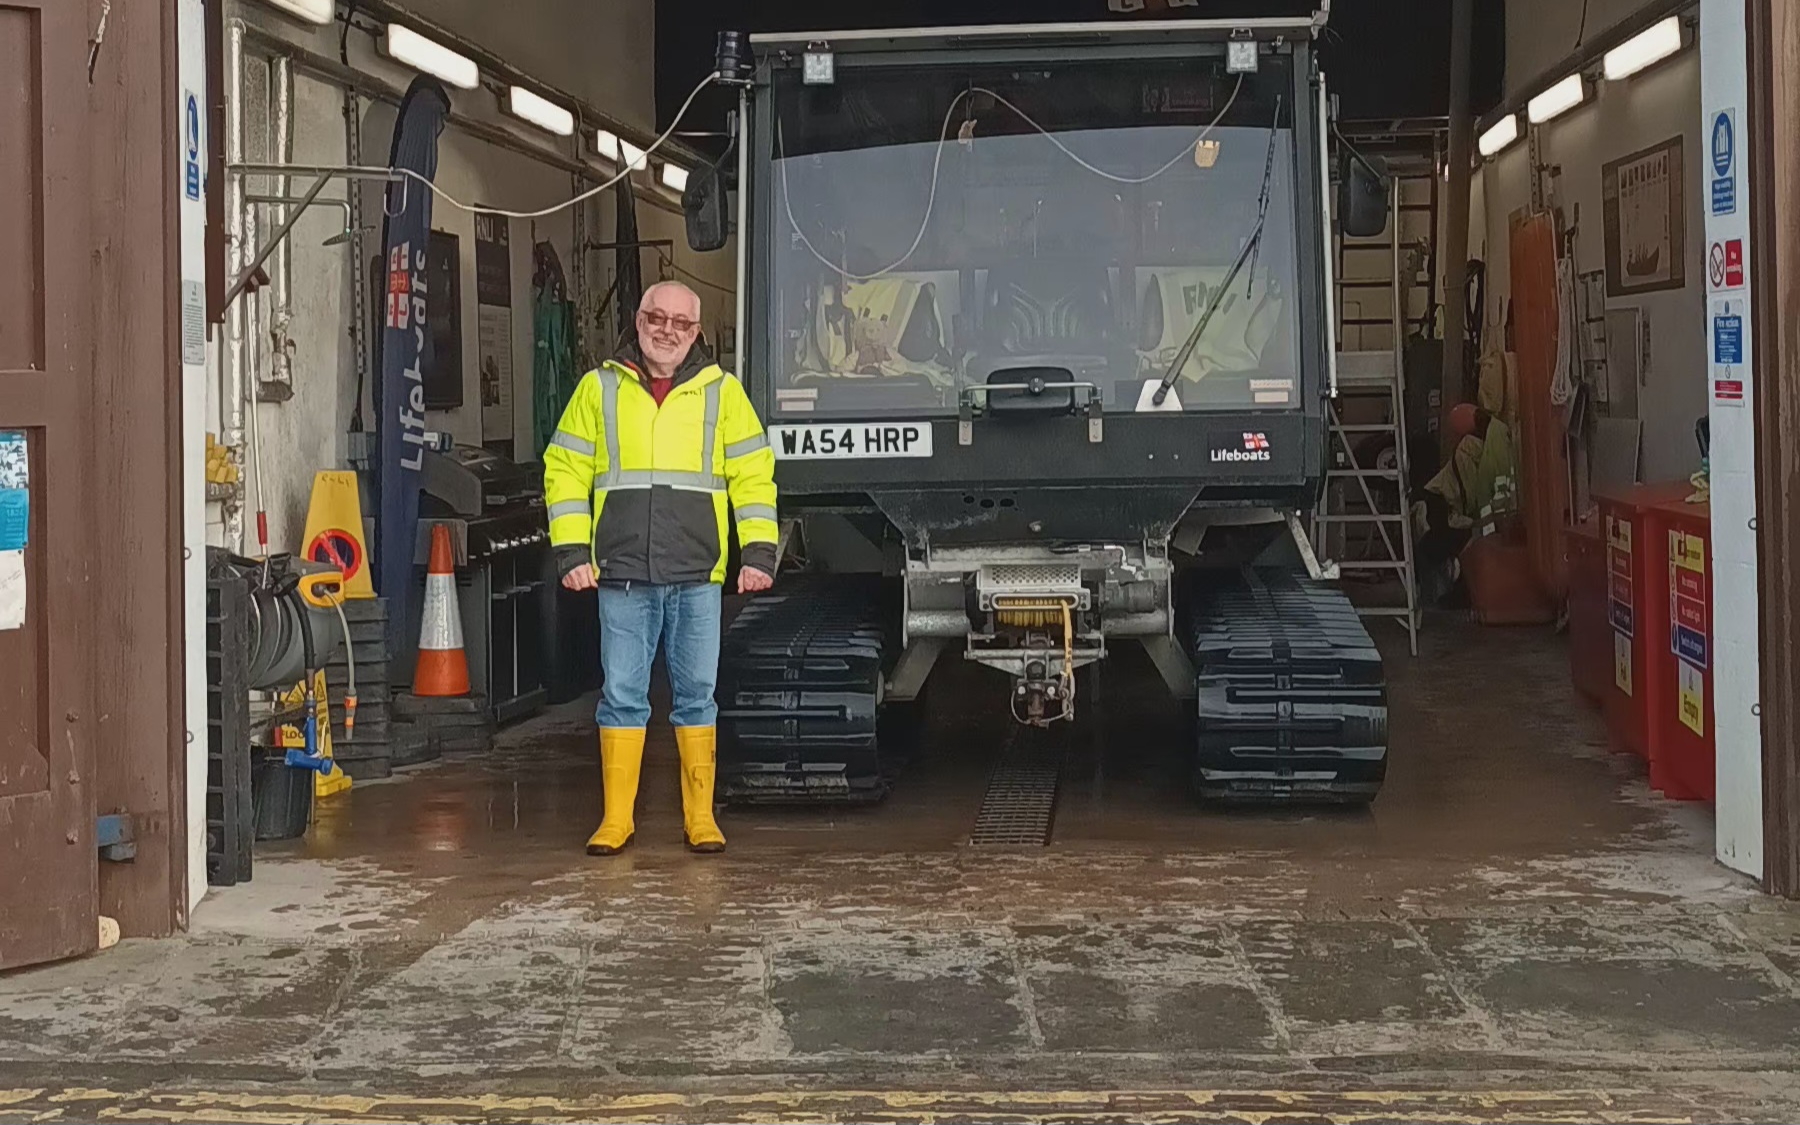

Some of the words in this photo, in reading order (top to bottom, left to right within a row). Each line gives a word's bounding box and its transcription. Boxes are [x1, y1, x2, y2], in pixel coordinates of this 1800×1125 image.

[1183, 281, 1238, 315] RNI
[781, 428, 855, 455] WA54
[864, 427, 919, 453] HRP
[1210, 447, 1271, 462] Lifeboats
